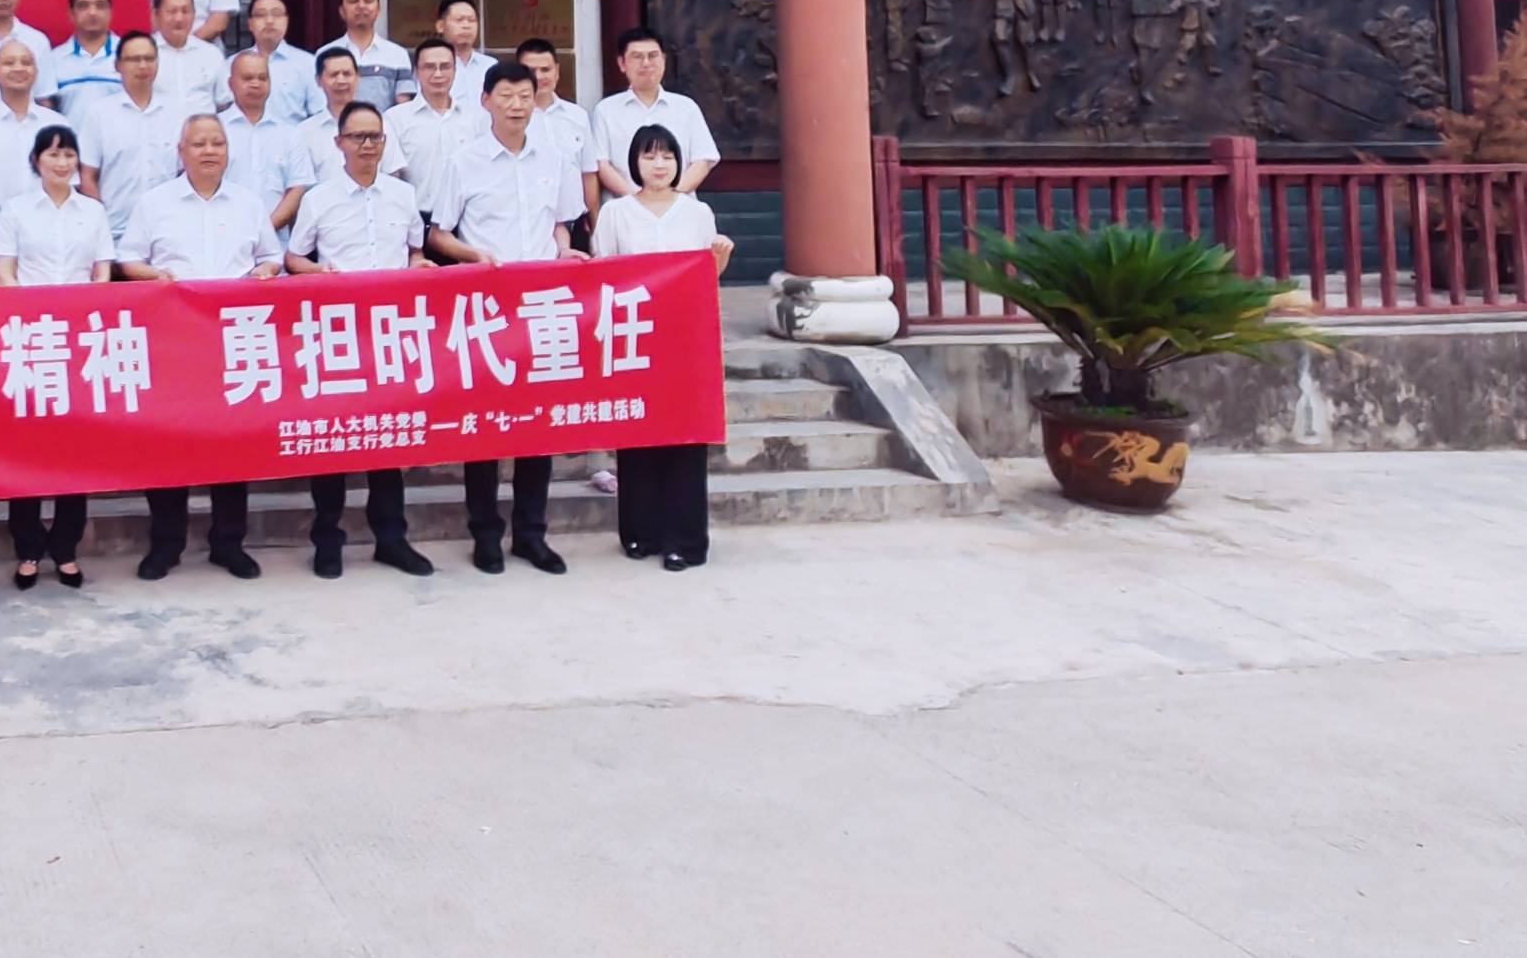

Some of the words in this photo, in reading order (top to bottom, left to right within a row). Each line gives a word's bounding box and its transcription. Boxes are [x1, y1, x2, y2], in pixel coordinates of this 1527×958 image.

[219, 283, 654, 406] 勇担时代重任
[278, 410, 427, 438] 江油市人大机关党委
[278, 430, 427, 456] 工行江油支行党总支
